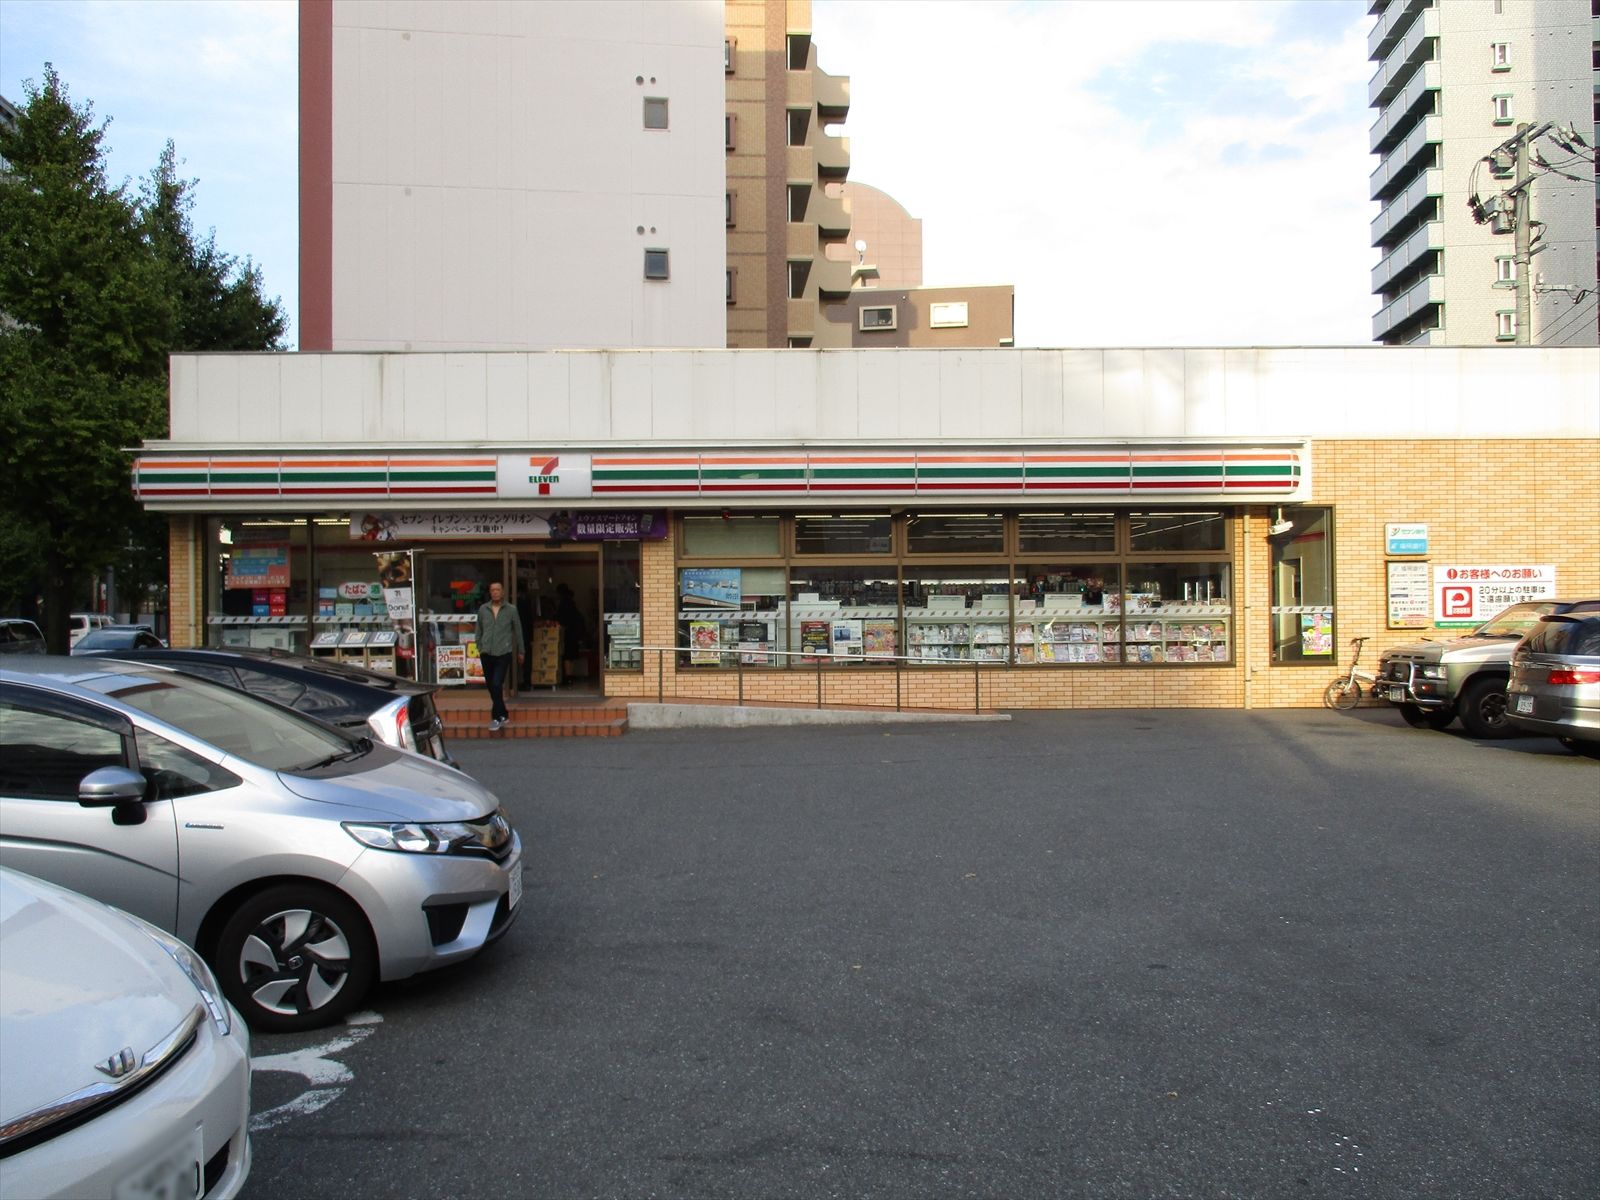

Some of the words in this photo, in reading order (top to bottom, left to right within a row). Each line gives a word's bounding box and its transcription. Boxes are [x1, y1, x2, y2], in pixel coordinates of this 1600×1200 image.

[1459, 569, 1543, 579] お客様へのお願い
[344, 584, 368, 595] たばこ
